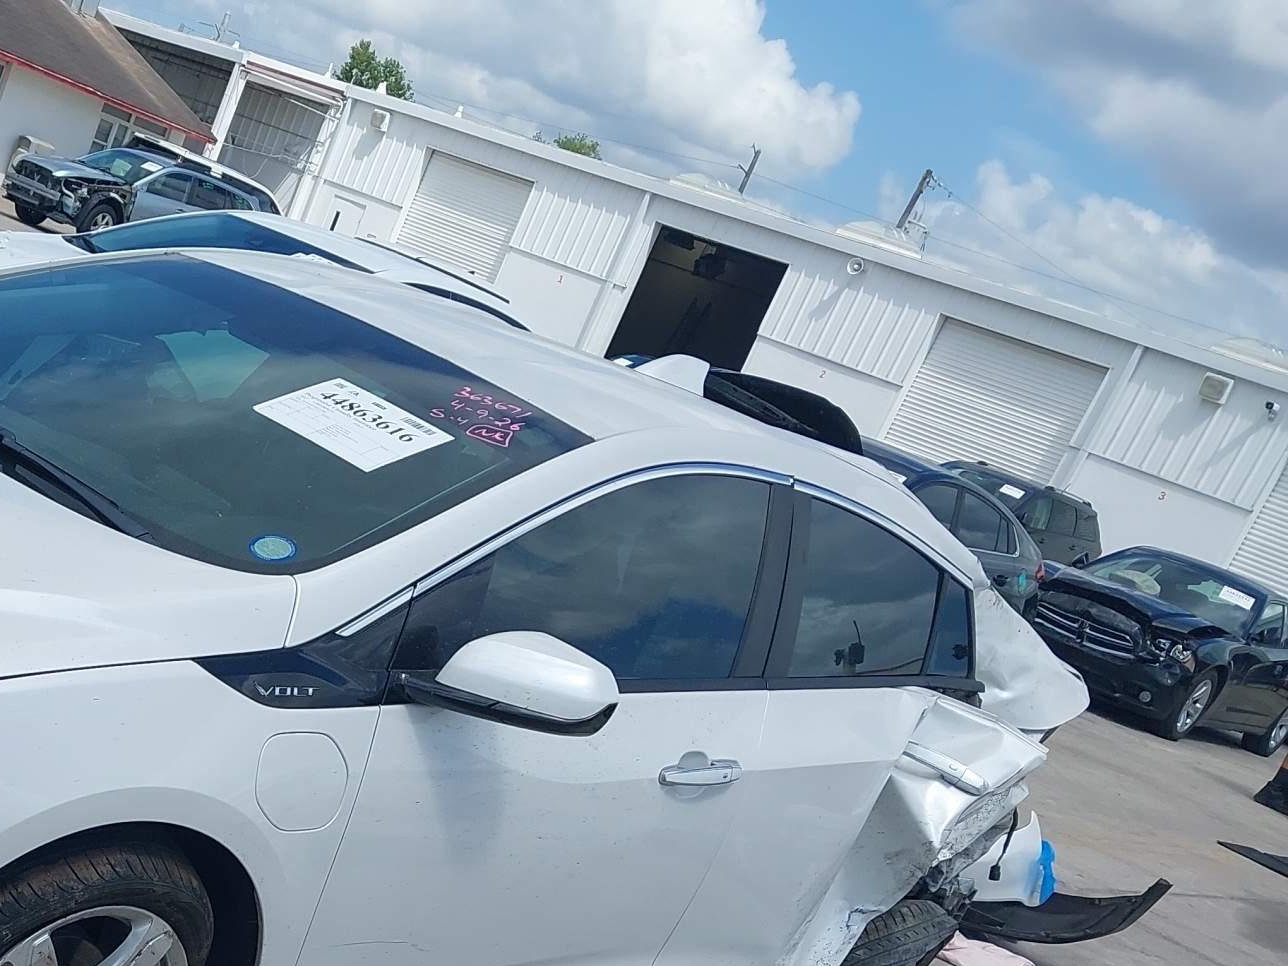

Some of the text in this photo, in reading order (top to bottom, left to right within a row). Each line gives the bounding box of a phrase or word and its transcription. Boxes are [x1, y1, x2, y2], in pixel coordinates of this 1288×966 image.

[818, 369, 826, 379] 2
[320, 391, 418, 442] 44863616
[1158, 491, 1166, 501] 3
[253, 680, 320, 697] VOLT
